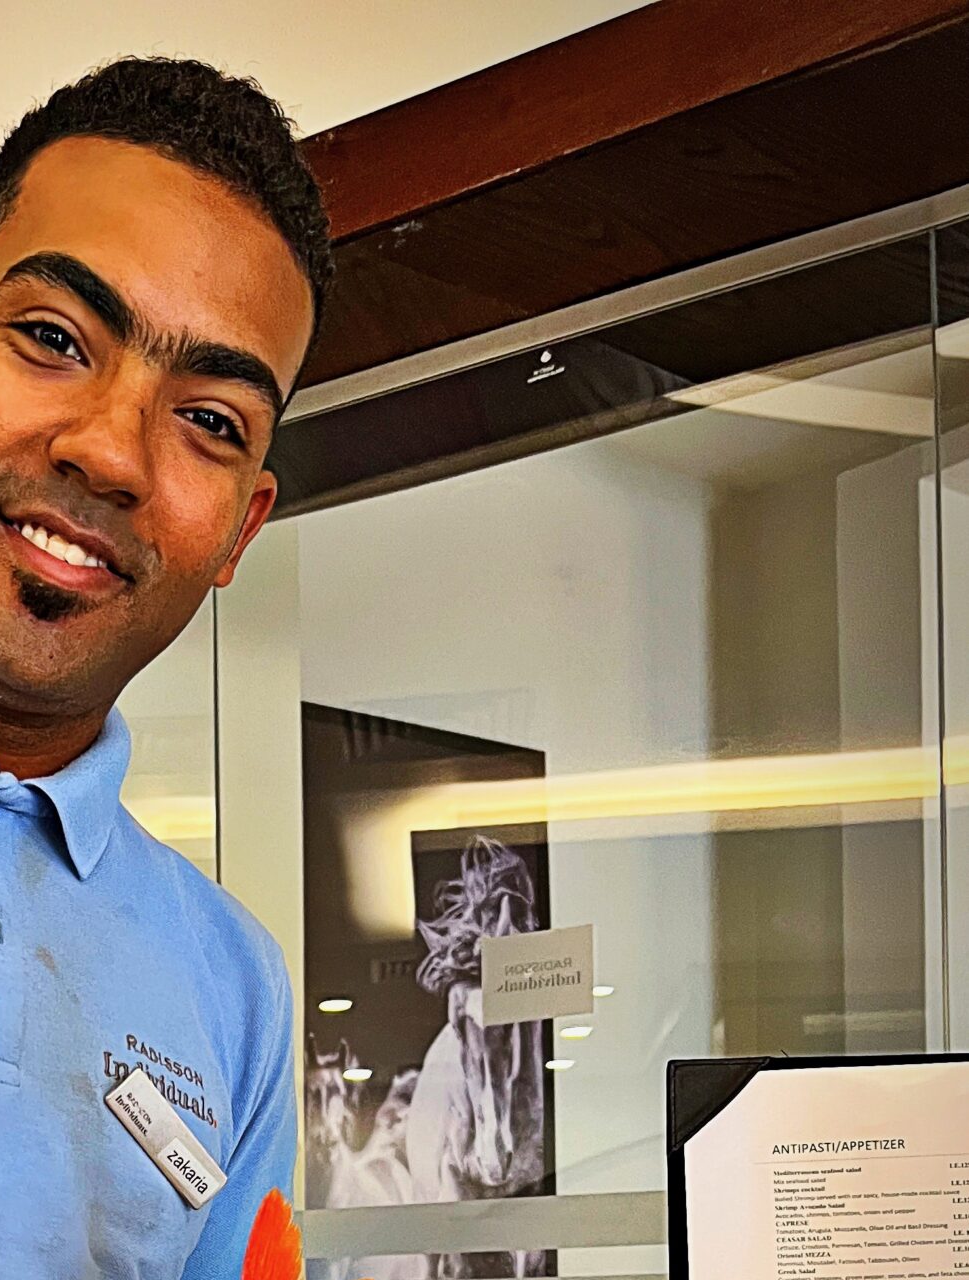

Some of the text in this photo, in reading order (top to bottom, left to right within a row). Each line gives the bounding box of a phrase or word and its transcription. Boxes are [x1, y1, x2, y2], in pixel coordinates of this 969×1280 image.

[126, 1034, 205, 1090] RADISSON
[103, 1051, 216, 1126] Inviduals
[772, 1139, 905, 1154] ANTIPASTI/APPETIZER
[166, 1150, 208, 1194] zakaria
